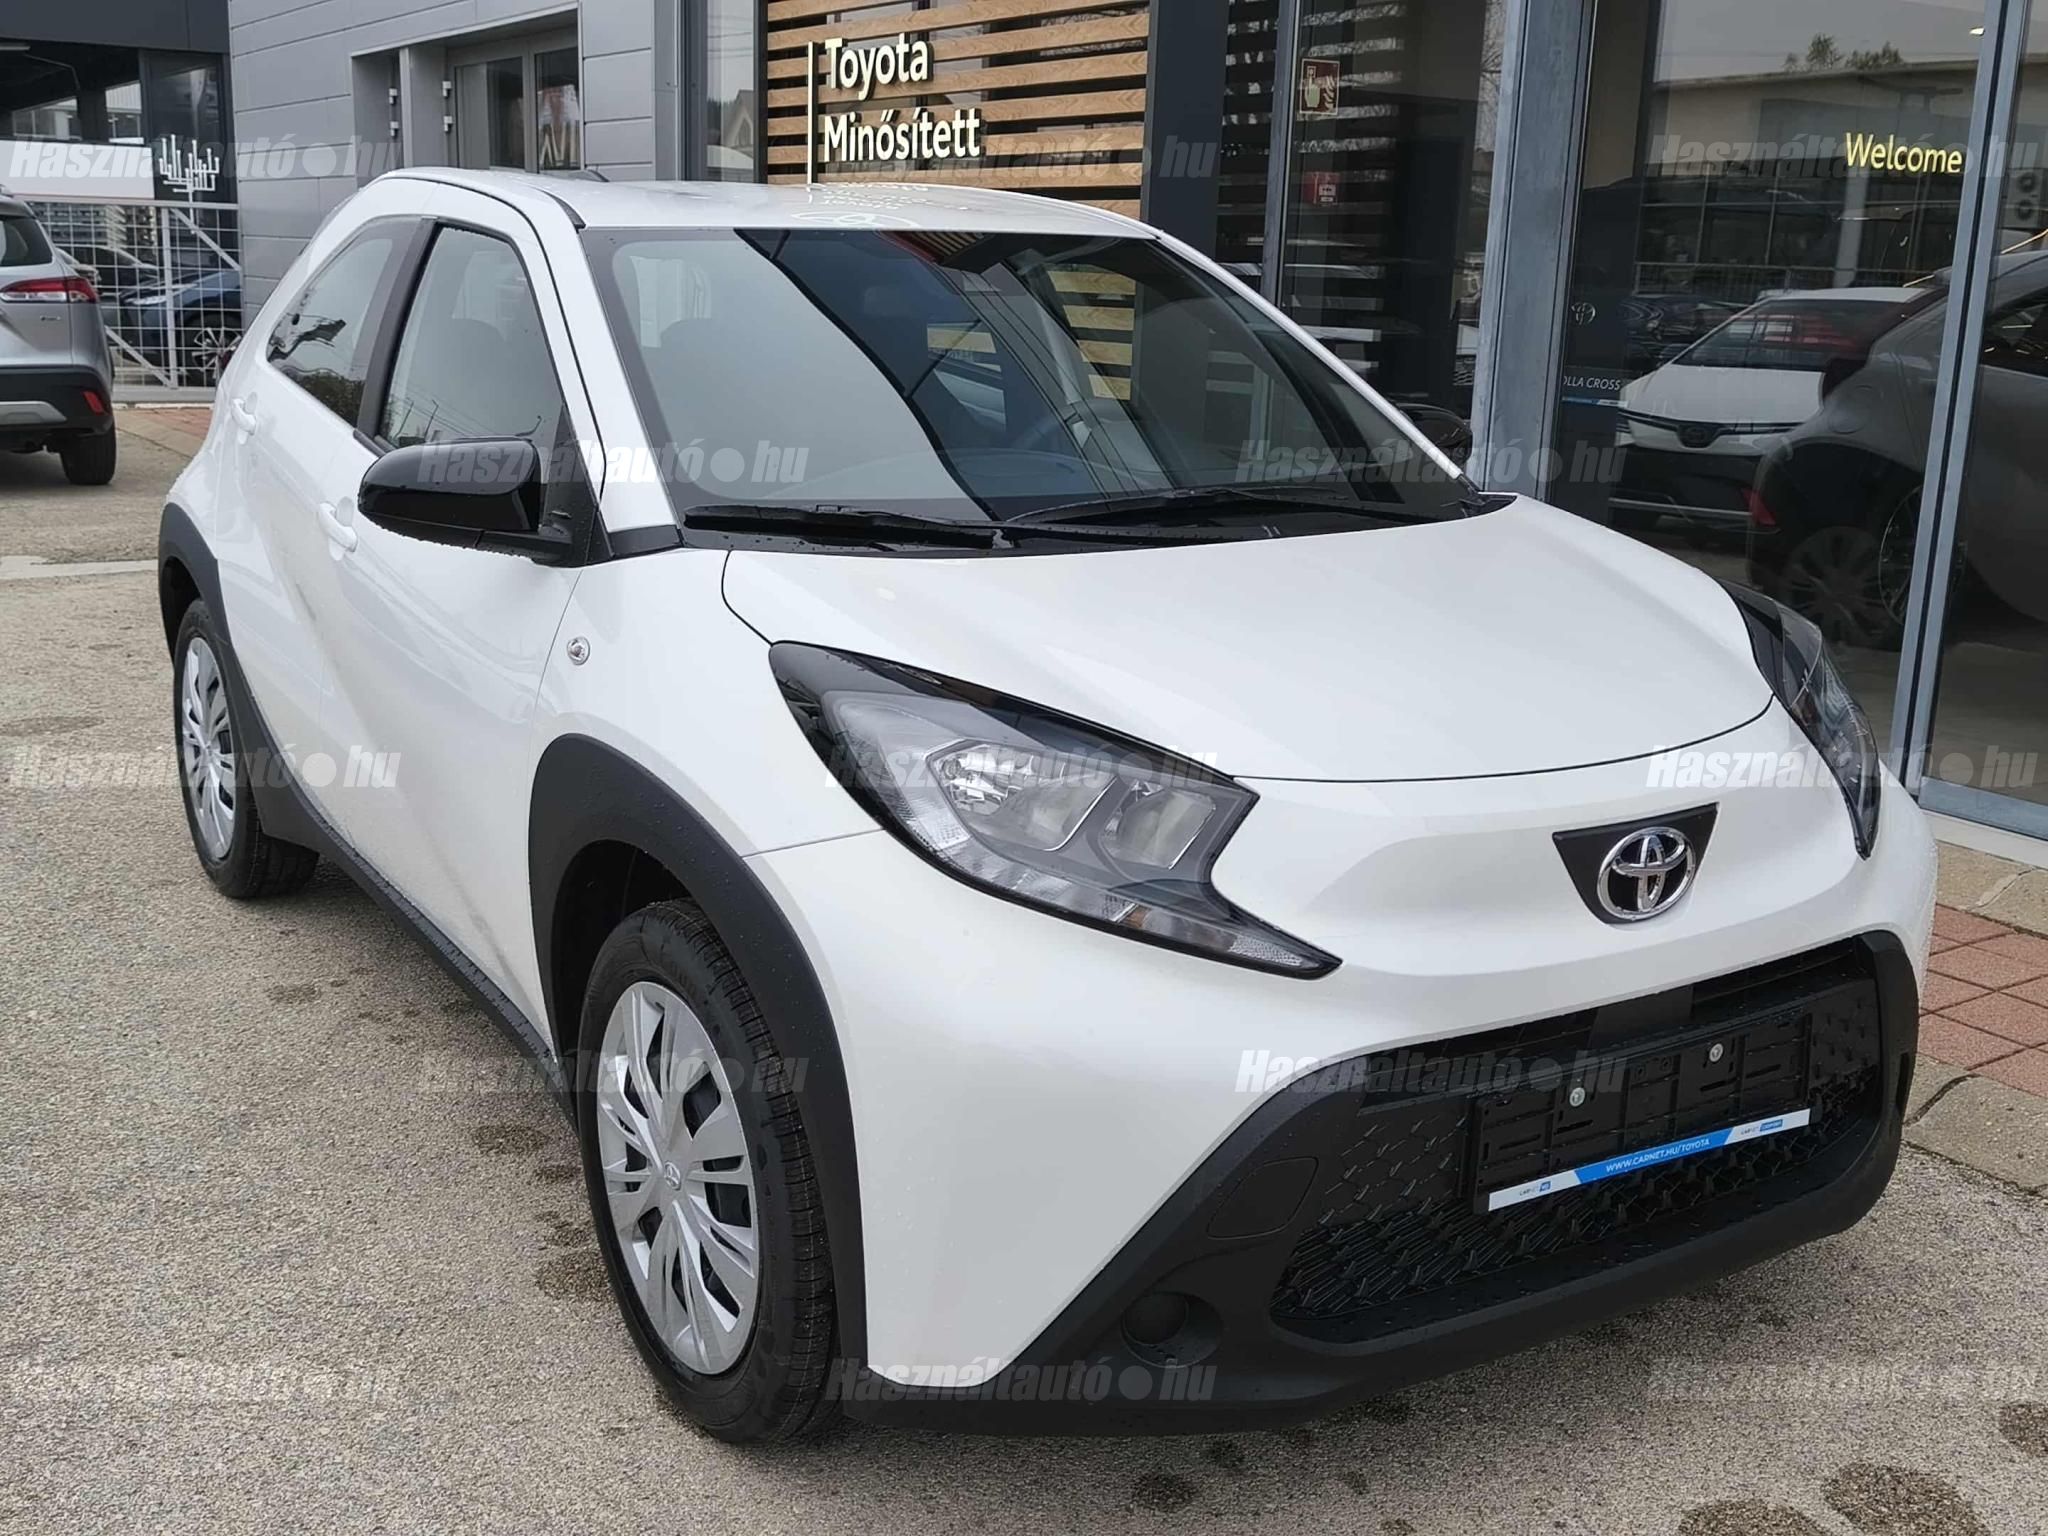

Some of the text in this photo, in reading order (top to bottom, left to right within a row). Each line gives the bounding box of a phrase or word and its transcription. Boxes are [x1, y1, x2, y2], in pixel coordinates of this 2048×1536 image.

[825, 33, 928, 100] Toyota
[824, 107, 980, 162] Minősített
[1846, 132, 1962, 173] Welcome
[1586, 378, 1621, 391] CROSS
